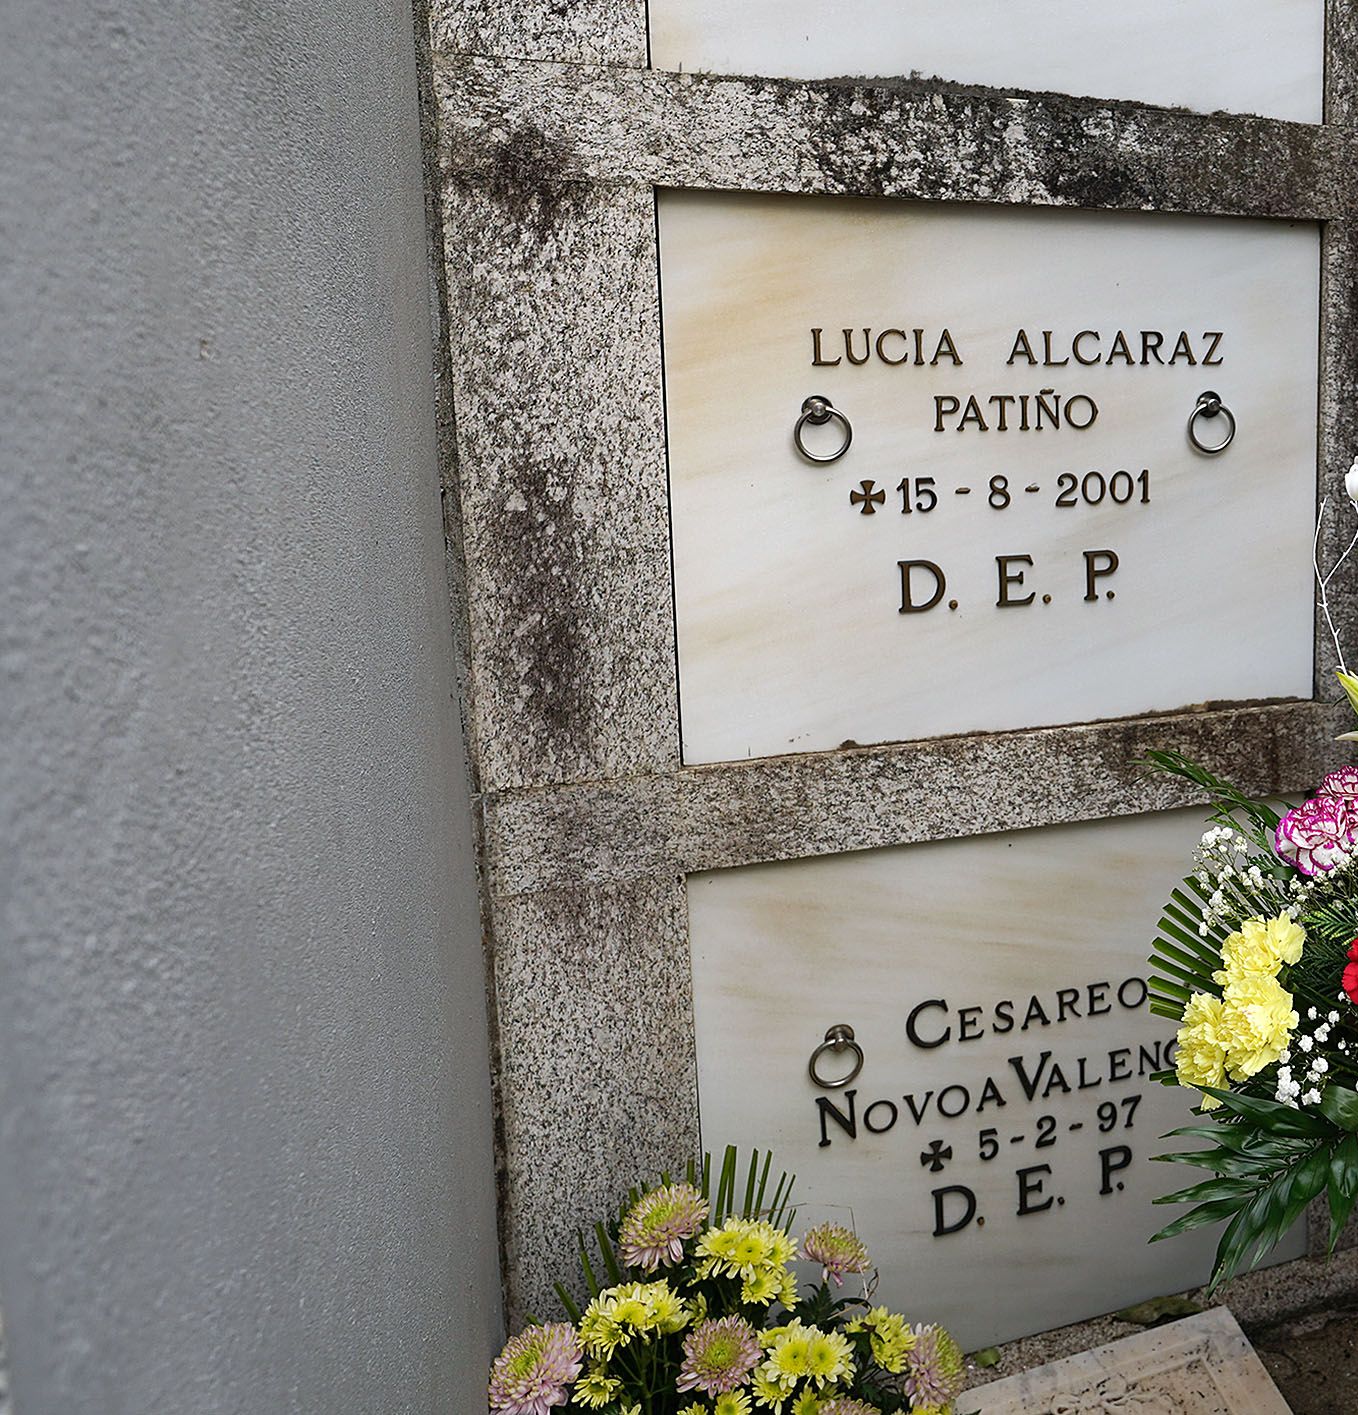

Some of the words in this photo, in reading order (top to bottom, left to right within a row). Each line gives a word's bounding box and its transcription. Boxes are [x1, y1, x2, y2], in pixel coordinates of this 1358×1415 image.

[810, 327, 964, 369] LUCIA
[1005, 327, 1225, 369] ALCARAZ
[933, 387, 1099, 433] PATIÑO
